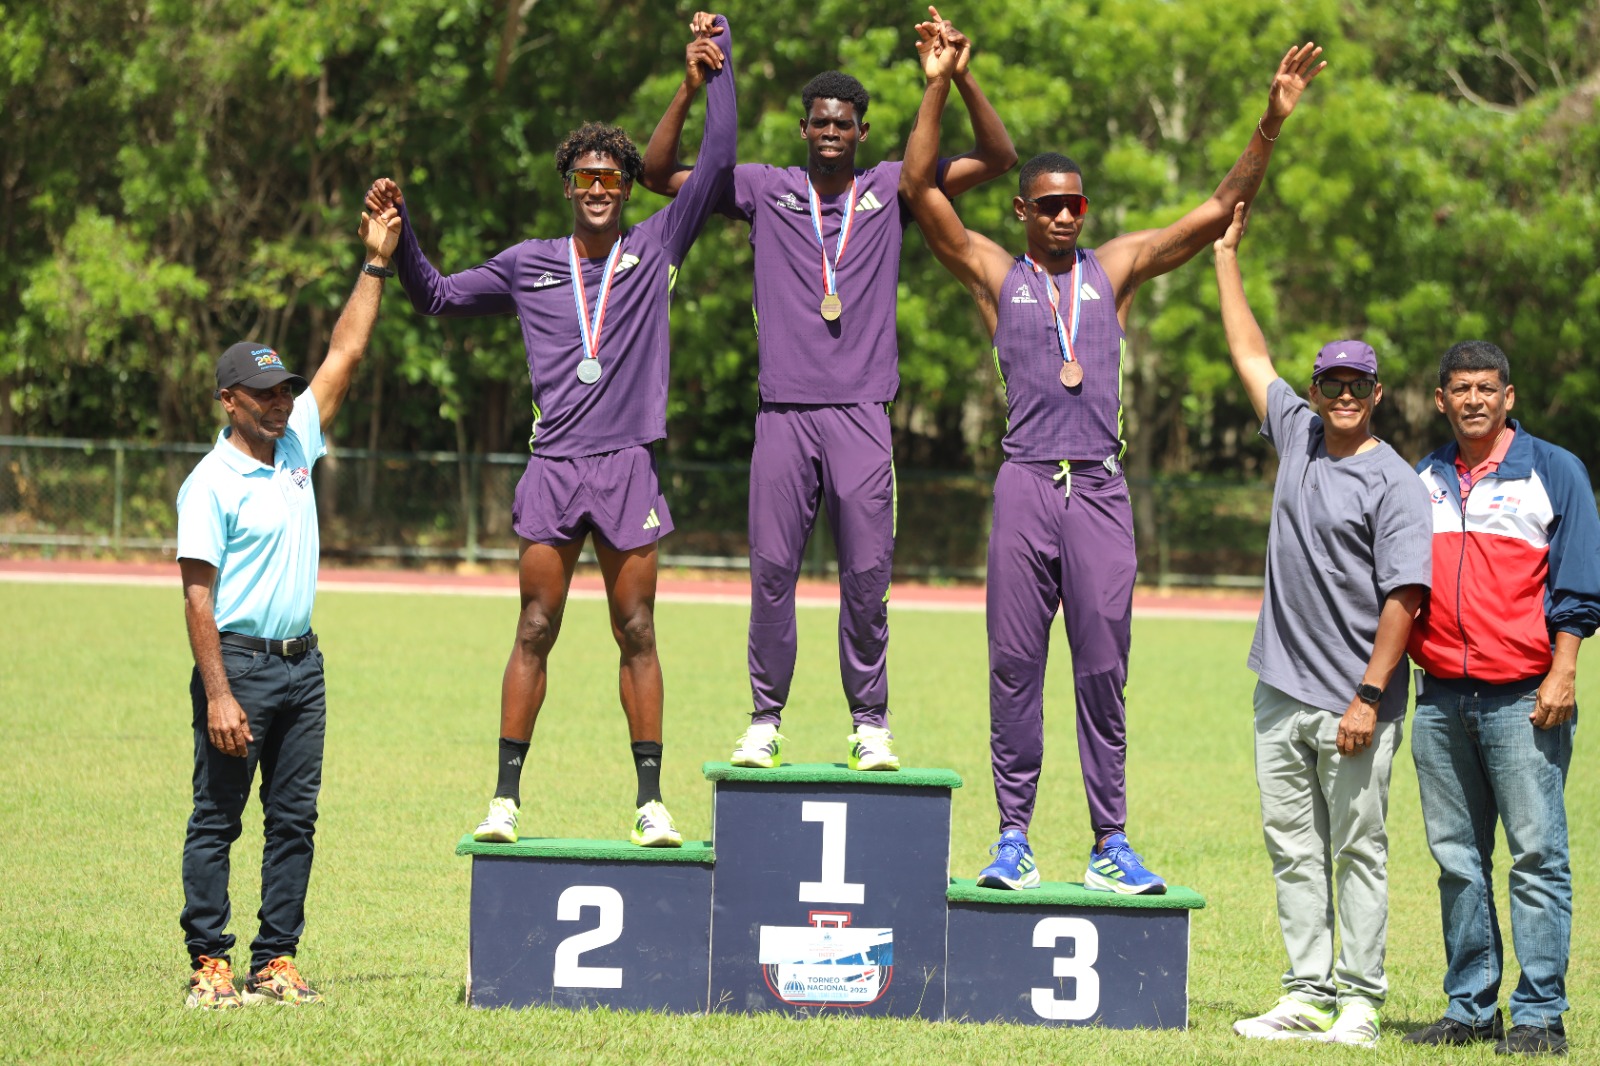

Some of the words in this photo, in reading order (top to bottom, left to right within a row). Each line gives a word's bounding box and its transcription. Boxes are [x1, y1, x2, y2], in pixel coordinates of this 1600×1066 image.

[799, 801, 865, 905] 1
[553, 886, 624, 990] 2
[806, 984, 848, 992] NACIONAL
[807, 976, 840, 984] TORNEO
[1030, 917, 1100, 1021] 3
